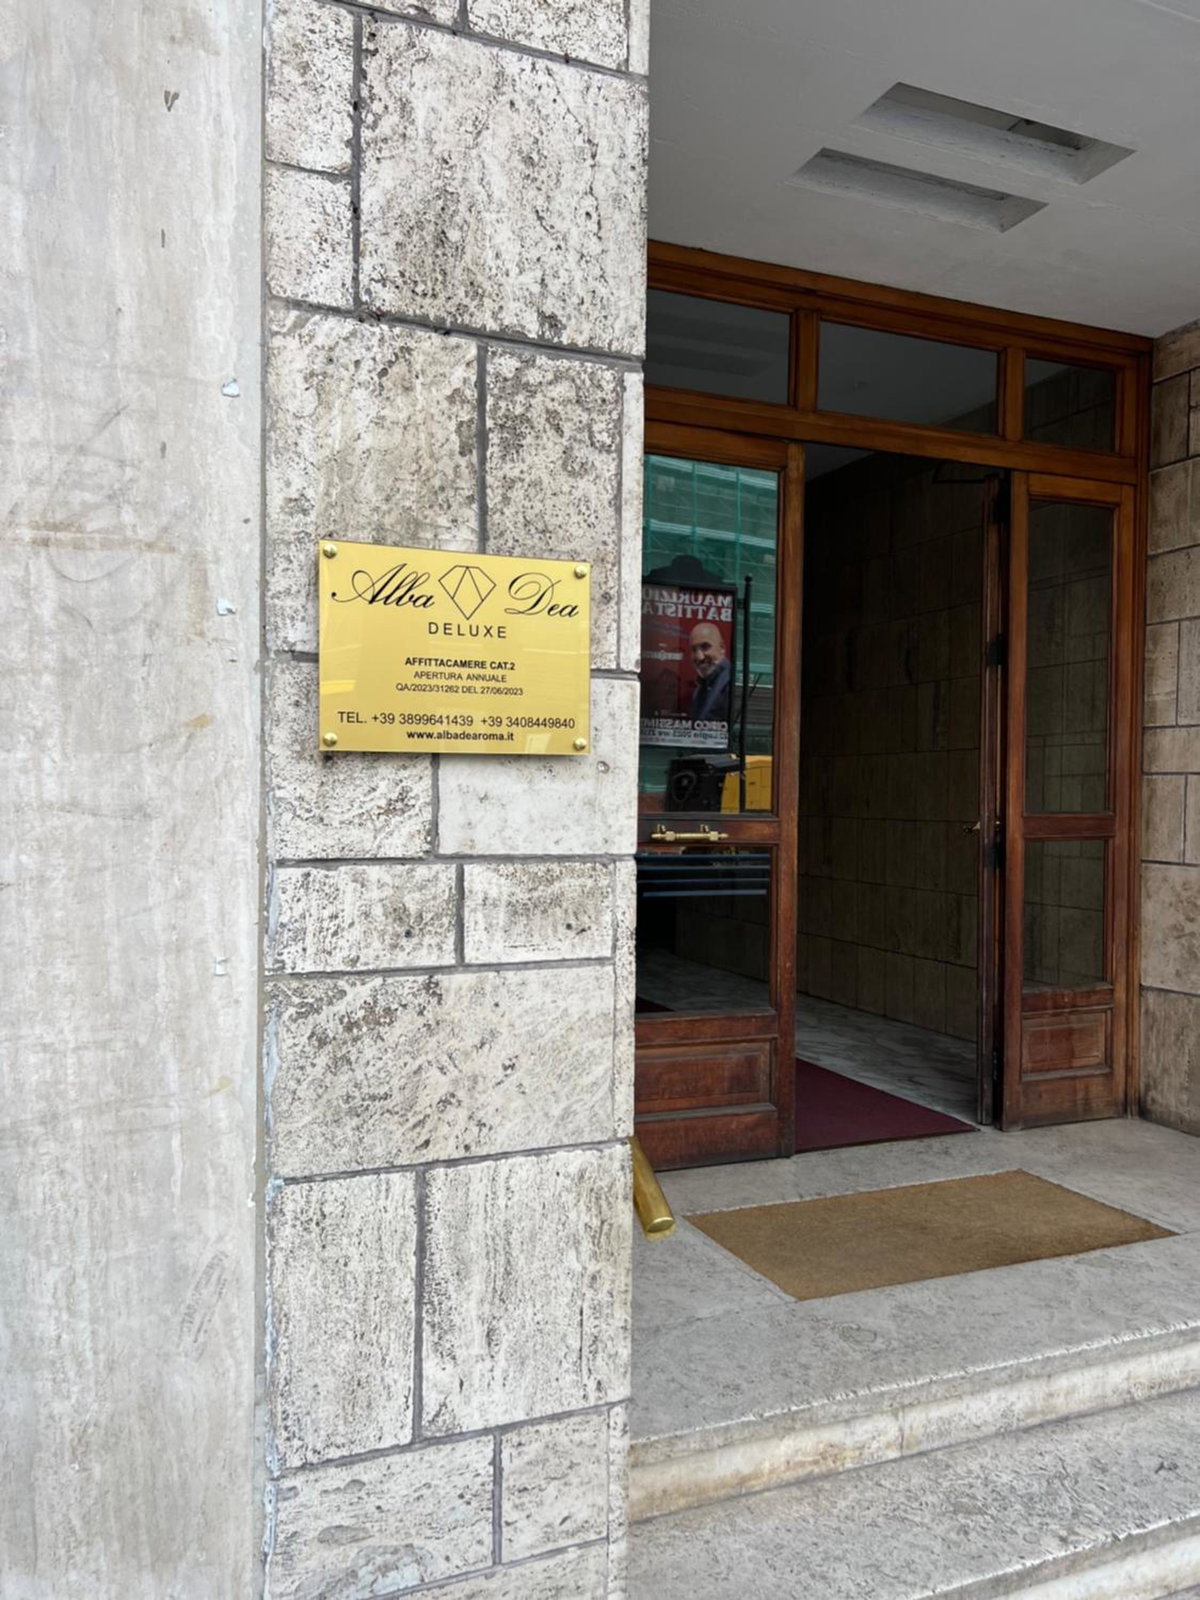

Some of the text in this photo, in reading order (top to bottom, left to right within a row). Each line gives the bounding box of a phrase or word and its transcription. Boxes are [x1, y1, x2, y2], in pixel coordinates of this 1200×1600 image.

[331, 563, 578, 618] Alba Dea
[428, 621, 507, 639] DELUXE
[405, 657, 516, 671] AFFITTACAMERE CAT.2
[413, 671, 507, 683] APERTURA ANNUALE
[395, 683, 524, 696] QA/2023/31262 DEL 27/06/2023
[338, 711, 575, 729] TEL. +39 3899641439 +39 3408449840
[406, 730, 514, 742] www.albadearoma.it
